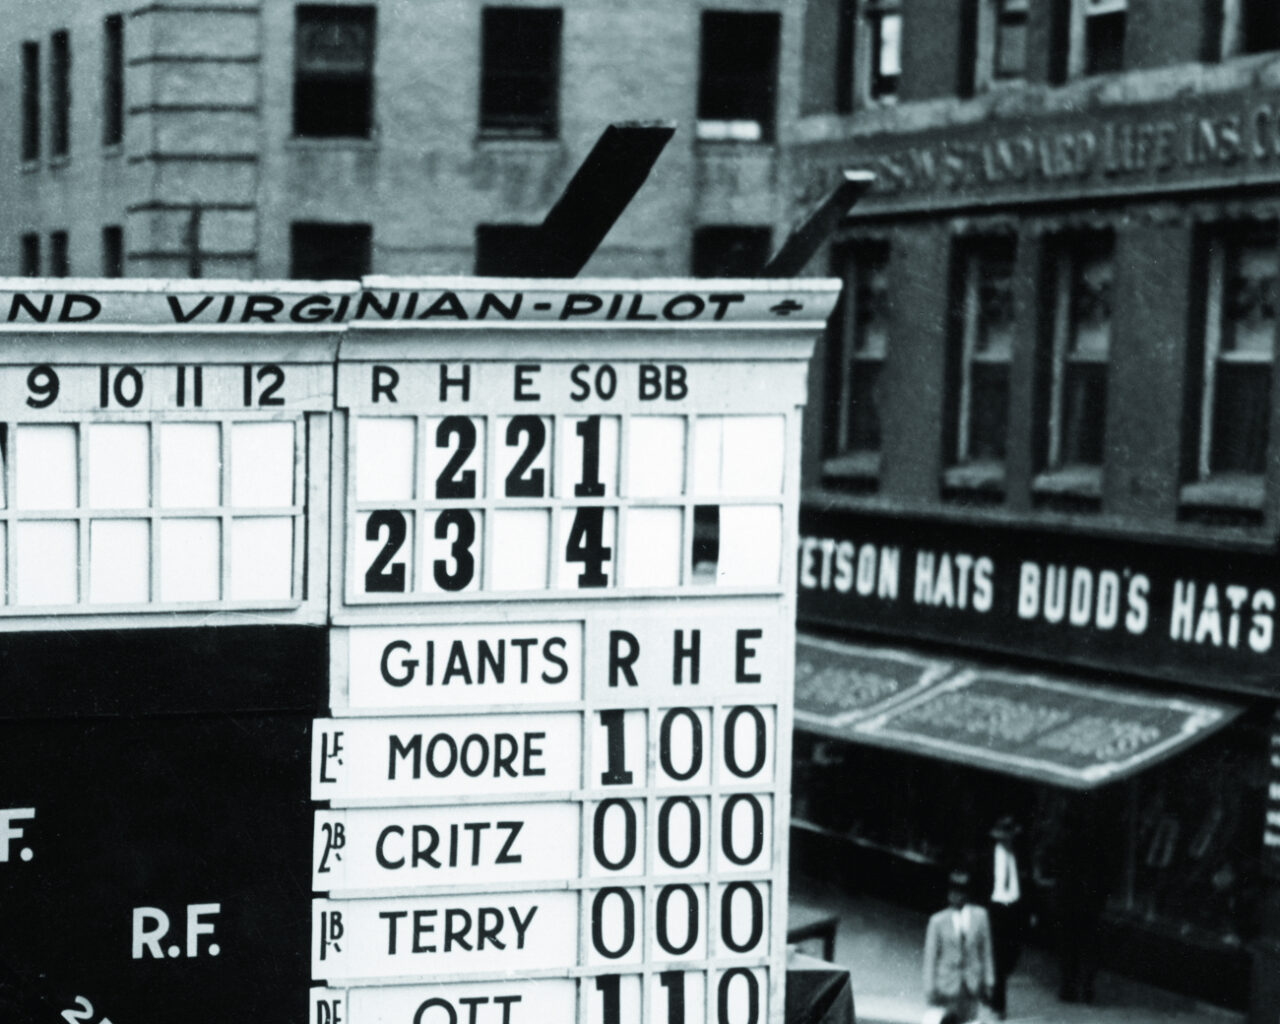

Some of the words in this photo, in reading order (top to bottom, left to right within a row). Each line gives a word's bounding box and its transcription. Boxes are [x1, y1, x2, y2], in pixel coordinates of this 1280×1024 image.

[166, 291, 745, 324] VIRGINIAN-PILOT
[26, 367, 59, 408] 9
[100, 367, 144, 408] 10
[176, 367, 202, 406] 11
[243, 365, 285, 406] 12
[372, 367, 400, 401] R
[440, 366, 471, 400] H
[514, 365, 541, 400] E
[571, 365, 617, 400] SO
[639, 365, 688, 399] BB
[436, 416, 477, 498] 2
[505, 415, 546, 497] 2
[575, 415, 605, 497] 1
[365, 509, 407, 592] 2
[434, 508, 475, 590] 3
[567, 507, 612, 588] 4
[800, 537, 899, 599] ETSON
[914, 552, 993, 611] HATS
[1018, 560, 1149, 634] BUDD'S
[1171, 581, 1275, 652] HATS
[381, 637, 568, 687] GIANTS
[609, 630, 640, 687] R
[673, 630, 700, 685] H
[736, 629, 762, 683] E
[388, 732, 545, 779] MOORE
[599, 709, 633, 785] 1
[660, 707, 702, 780] 0
[725, 705, 766, 778] 0
[376, 822, 524, 869] CRITZ
[594, 798, 636, 870] 0
[659, 796, 700, 868] 0
[722, 793, 763, 865] 0
[133, 903, 220, 958] R.F.
[379, 906, 538, 955] TERRY
[592, 887, 634, 958] 0
[657, 884, 698, 955] 0
[721, 881, 763, 953] 0
